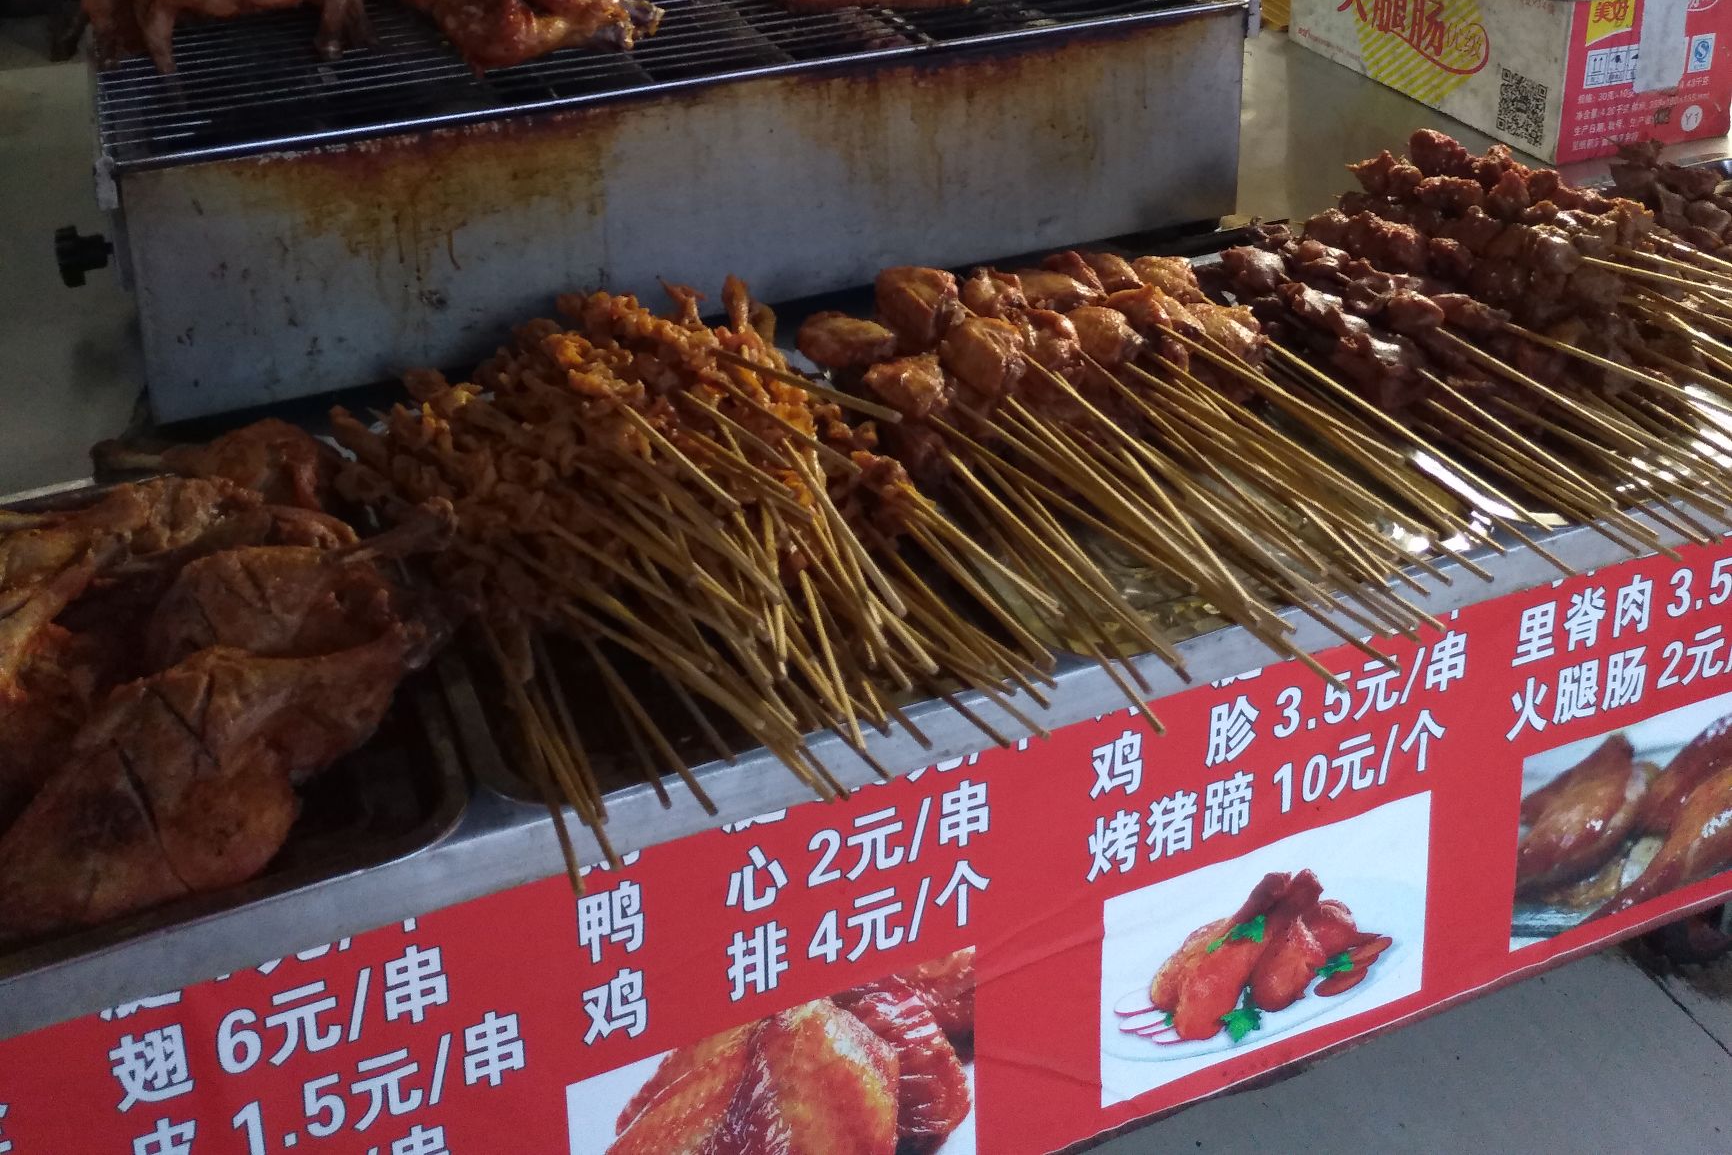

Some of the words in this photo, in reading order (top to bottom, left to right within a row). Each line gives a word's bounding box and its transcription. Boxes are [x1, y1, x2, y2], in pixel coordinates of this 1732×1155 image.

[1505, 645, 1648, 742] 火腿肠
[1510, 574, 1653, 668] 里脊肉
[1086, 771, 1254, 883] 烤猪蹄
[1272, 709, 1446, 814] 10元/个
[1089, 730, 1144, 800] 鸡
[1204, 694, 1260, 767] 胗
[1273, 630, 1467, 739] 3.5元/串
[576, 880, 644, 963] 鸭
[726, 845, 788, 912] 心
[806, 778, 991, 890] 2元/串
[582, 967, 648, 1046] 鸡
[726, 920, 789, 1003] 排
[807, 860, 991, 965] 4元/个
[107, 1022, 195, 1113] 翅
[215, 943, 450, 1076] 6元/串
[231, 1009, 526, 1155] 1.5元/串
